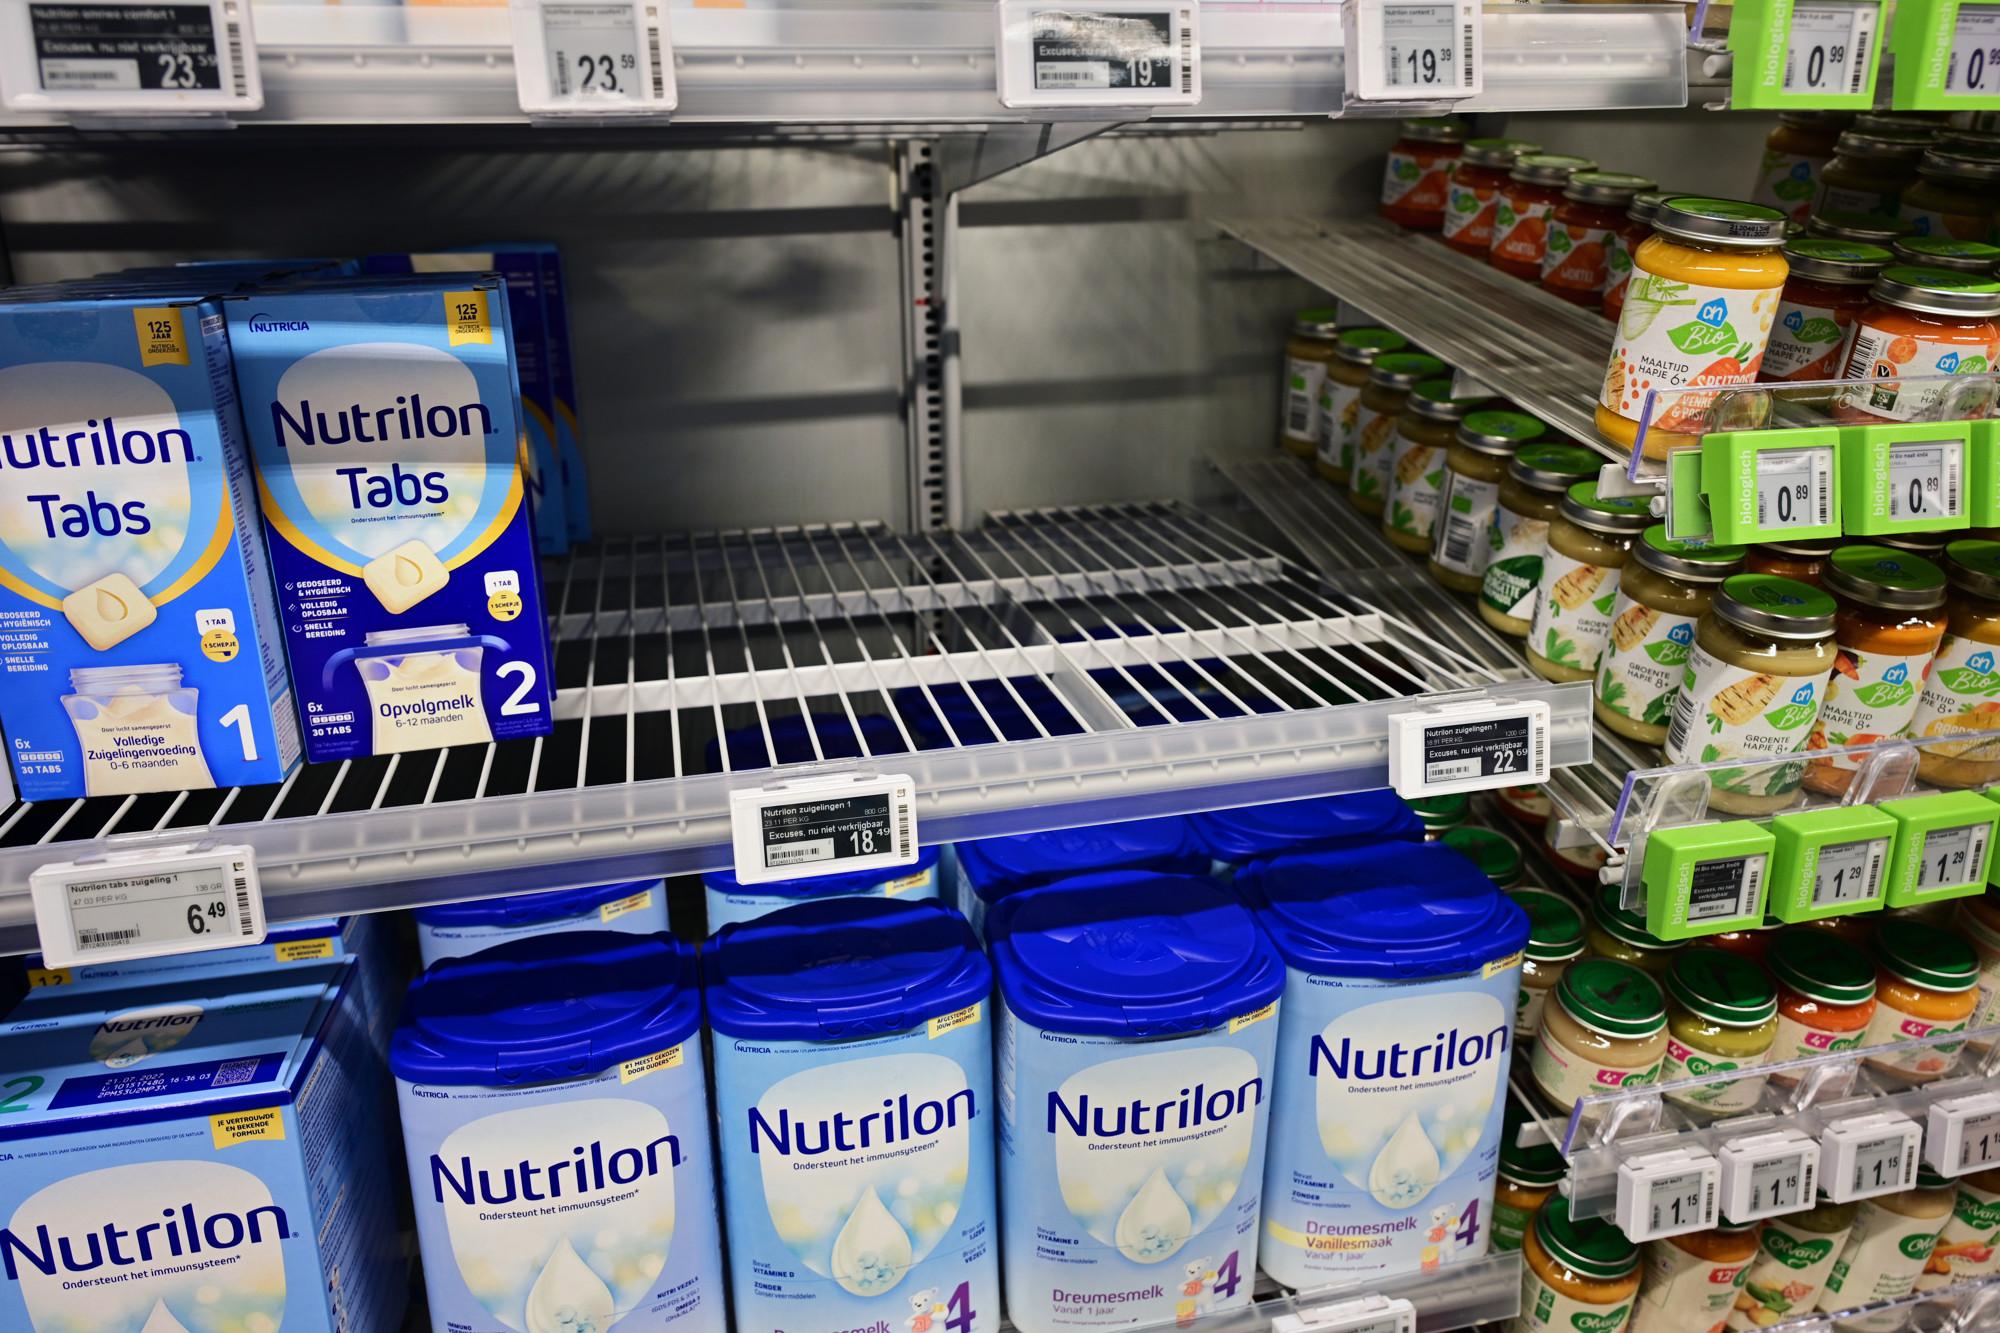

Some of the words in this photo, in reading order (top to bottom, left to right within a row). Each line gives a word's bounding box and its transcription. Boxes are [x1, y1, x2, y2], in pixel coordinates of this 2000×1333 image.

[1763, 0, 1789, 87] biologisch
[1927, 0, 1954, 89] biologisch
[1039, 46, 1079, 57] Excuses,
[456, 304, 478, 315] 125
[147, 321, 172, 333] 125
[252, 320, 309, 332] NUTRICIA
[1798, 321, 1834, 338] Bio
[1684, 325, 1734, 349] Bio
[1769, 348, 1794, 360] HAPJE
[1771, 340, 1813, 354] GROENTE
[1640, 355, 1689, 373] MAALTIJD
[1638, 365, 1668, 380] HAPJE
[1671, 374, 1687, 386] 6+
[270, 394, 492, 447] Nutrilon
[0, 417, 195, 469] utrilon
[336, 463, 449, 509] Tabs
[1873, 443, 1887, 516] biologisch
[1741, 450, 1753, 525] biologisch
[27, 491, 151, 538] Tabs
[296, 579, 342, 588] GEDOSEERD
[305, 586, 351, 596] HYGIËNISCH
[301, 601, 338, 609] VOLLEDIG
[0, 611, 41, 619] EDOSEERD
[302, 608, 348, 617] OPLOSBAAR
[3, 619, 51, 628] HYGIËNISCH
[305, 622, 333, 630] SNELLE
[306, 629, 346, 638] BEREIDING
[1, 642, 49, 650] OPLOSBAAR
[209, 641, 237, 649] SCHEPJE
[5, 656, 35, 664] SNELLE
[7, 664, 49, 672] BEREIDING
[1629, 662, 1671, 680] GROENTE
[420, 681, 457, 690] samengeperst
[1627, 669, 1653, 683] HAPJE
[1655, 679, 1670, 688] 8+
[1949, 672, 2000, 690] Bio
[496, 661, 540, 716] 2
[1867, 685, 1911, 704] Bio
[307, 702, 323, 712] 6x
[380, 695, 475, 719] Opvolgmelk
[1825, 705, 1873, 720] MAALTIJD
[395, 718, 418, 728] 6-12
[420, 713, 463, 725] maanden
[1777, 706, 1815, 728] Bio
[1823, 712, 1853, 726] HAPJE
[1856, 720, 1871, 730] 8+
[131, 724, 171, 732] samengeperst
[219, 704, 258, 761] 1
[312, 728, 324, 736] 30
[326, 726, 351, 735] TABS
[1426, 728, 1453, 738] Nutrilon
[1455, 724, 1493, 735] zuigelingen
[15, 739, 31, 749] 6x
[113, 735, 165, 748] Volledige
[1745, 734, 1791, 743] GROENTE
[88, 745, 196, 760] Zuigelingenvoeding
[1429, 749, 1459, 759] Excuses,
[1471, 746, 1484, 754] niet
[1485, 741, 1523, 752] verkrijgbaar
[1743, 742, 1773, 752] HAPJE
[1775, 745, 1788, 754] 8+
[21, 766, 34, 774] 30
[35, 765, 62, 774] TABS
[110, 760, 129, 770] 0-6
[132, 758, 178, 769] maanden
[764, 806, 797, 818] Nutrilon
[799, 801, 845, 814] zuigelingen
[783, 816, 798, 824] PER
[769, 829, 806, 840] Excuses,
[808, 827, 819, 835] nu
[820, 825, 836, 834] niet
[837, 820, 885, 833] verkrijgbaar
[1902, 832, 1921, 893] biologisch
[71, 882, 107, 893] Nutrilon
[110, 879, 128, 889] tabs
[131, 875, 171, 887] zuigeling
[1796, 847, 1816, 908] biologisch
[211, 882, 223, 890] GR
[96, 896, 113, 904] PER
[115, 893, 128, 901] KG
[1671, 862, 1690, 925] biologisch
[1309, 977, 1343, 988] NUTRICIA
[952, 1012, 975, 1028] DREUMES
[1041, 1034, 1078, 1044] NUTRICIA
[735, 1043, 771, 1053] NUTRICIA
[1309, 1025, 1508, 1080] Nutrilon
[634, 1057, 653, 1068] MEEST
[627, 1066, 644, 1076] DOOR
[0, 1076, 45, 1112] 2
[414, 1088, 449, 1099] NUTRICIA
[1348, 1084, 1398, 1094] Ondersteunt
[1400, 1083, 1413, 1091] het
[1048, 1077, 1262, 1137] Nutrilon
[226, 1113, 275, 1125] VERTROUWDE
[237, 1121, 269, 1131] BEKENDE
[748, 1089, 975, 1155] Nutrilon
[232, 1128, 266, 1139] FORMULE
[1088, 1141, 1141, 1151] Ondersteunt
[1143, 1139, 1157, 1147] het
[430, 1134, 681, 1205] Nutrilon
[793, 1158, 848, 1171] Ondersteunt
[850, 1156, 865, 1165] het
[1293, 1178, 1326, 1188] VITAMINE
[1291, 1190, 1320, 1200] ZONDER
[479, 1207, 538, 1221] Ondersteunt
[540, 1205, 556, 1215] het
[1306, 1217, 1417, 1235] Dreumesmelk
[1455, 1198, 1480, 1246] 4
[0, 1203, 290, 1281] Nutrilon
[1037, 1233, 1071, 1244] VITAMINE
[1306, 1235, 1393, 1250] Vanillesmaak
[1037, 1246, 1065, 1256] ZONDER
[62, 1272, 129, 1290] Ondersteunt
[130, 1269, 148, 1280] het
[753, 1268, 787, 1277] VITAMINE
[1214, 1250, 1241, 1298] 4
[657, 1287, 676, 1299] NUTRI
[677, 1276, 698, 1291] VEZELS
[754, 1282, 782, 1291] ZONDER
[754, 1289, 816, 1300] Conserveermiddelen
[1052, 1285, 1164, 1304] Dreumesmelk
[1053, 1304, 1083, 1315] Vanaf
[1095, 1306, 1116, 1318] jaar
